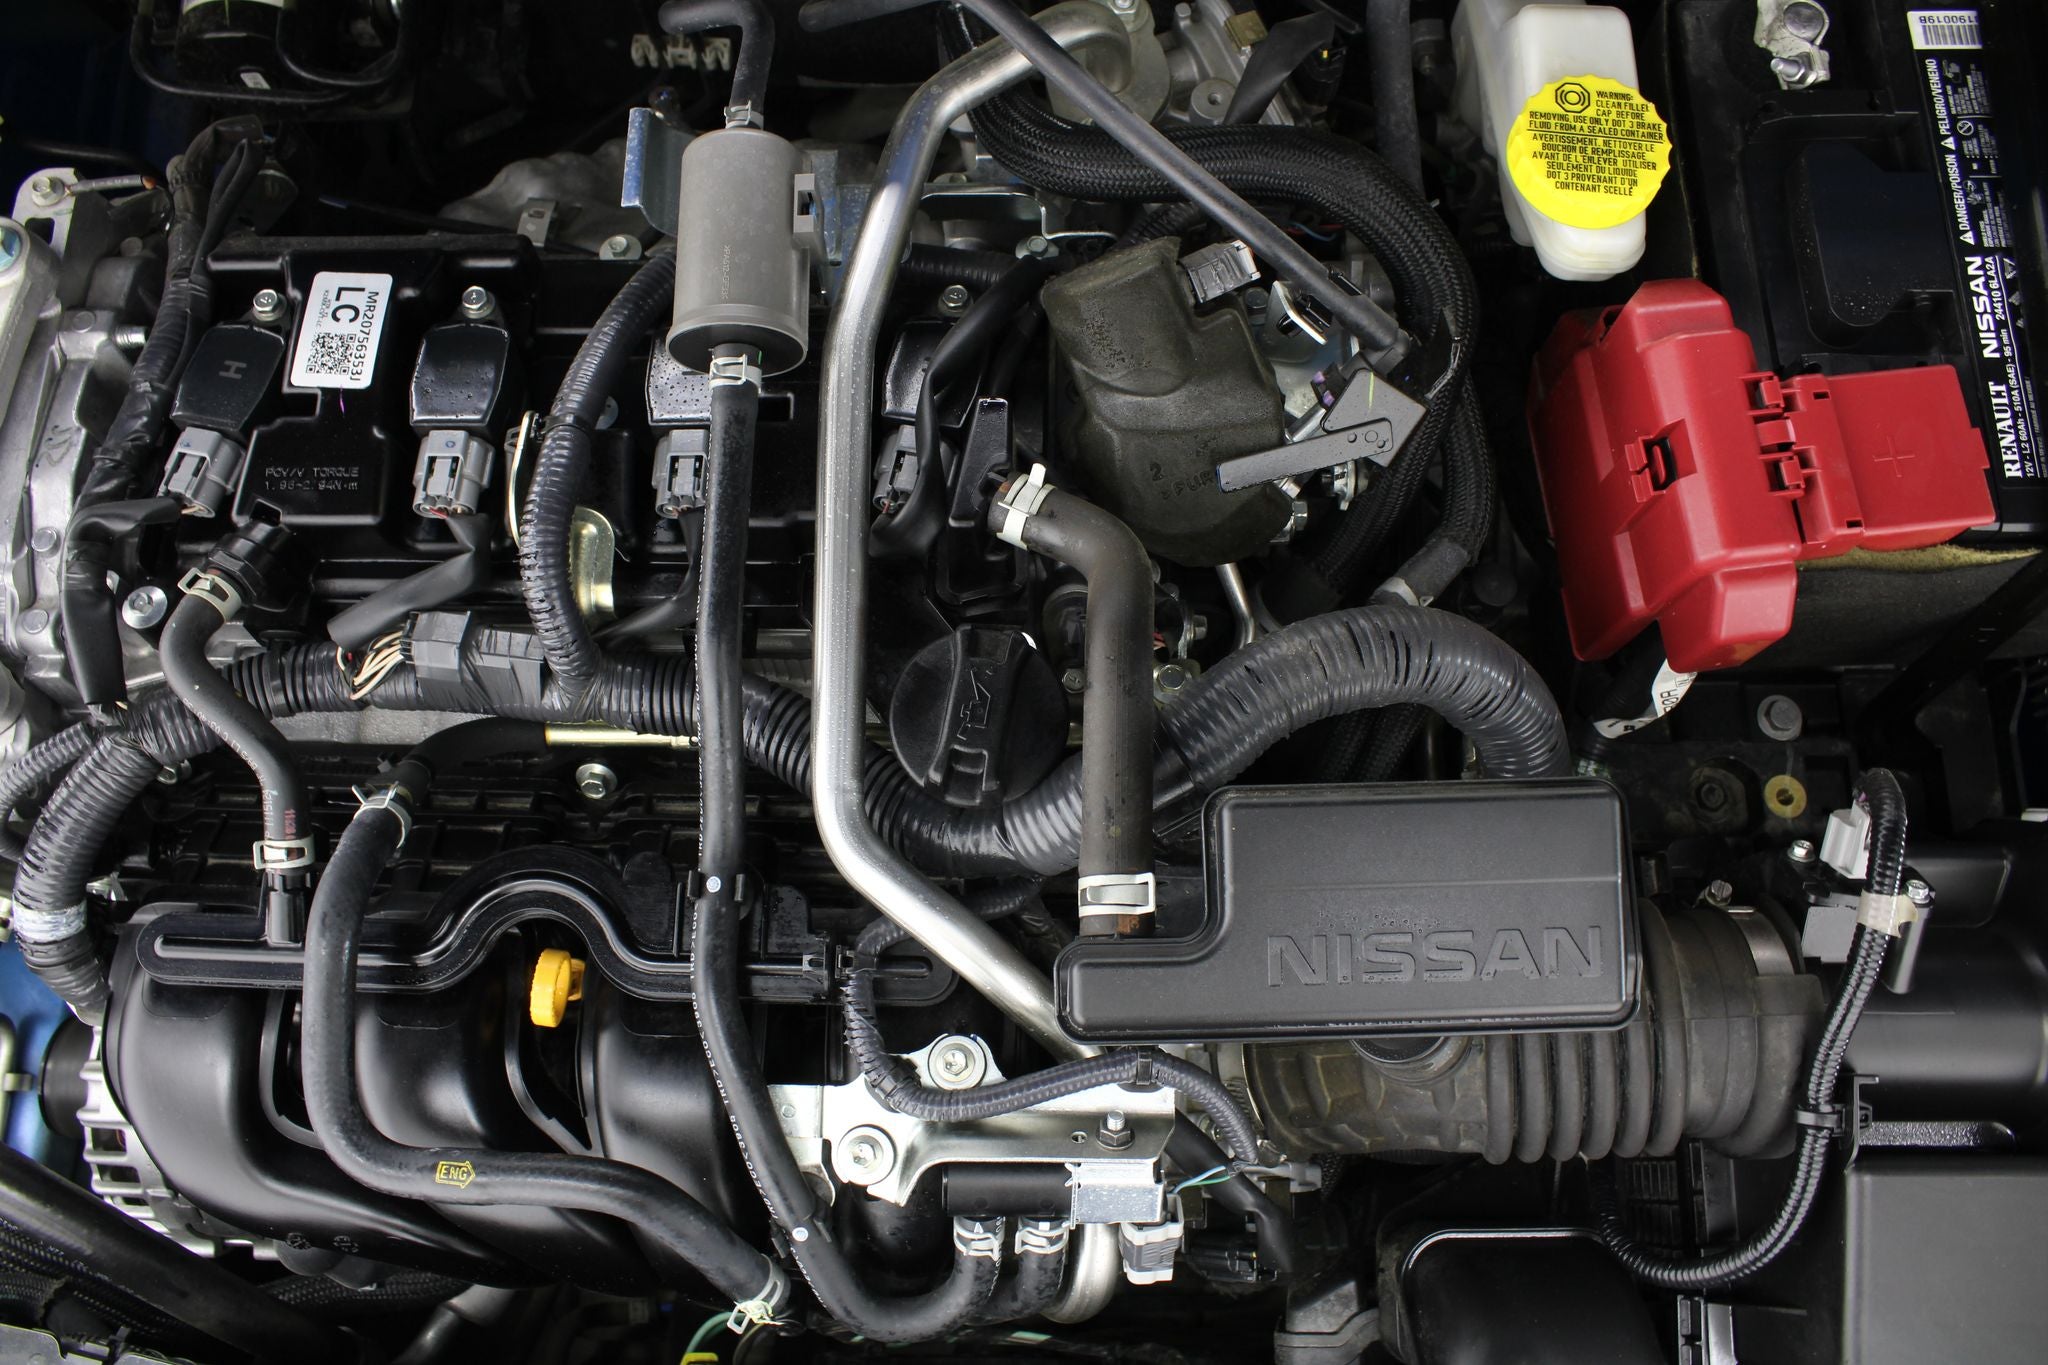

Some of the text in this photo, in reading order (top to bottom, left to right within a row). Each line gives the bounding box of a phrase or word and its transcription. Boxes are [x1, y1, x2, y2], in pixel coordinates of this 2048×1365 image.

[1596, 100, 1621, 109] CLEAN
[1573, 115, 1588, 124] USE
[1589, 116, 1609, 126] ONLY
[1612, 119, 1626, 127] DOT
[1629, 121, 1634, 129] 3
[1636, 122, 1662, 132] BRAKE
[1596, 109, 1645, 121] CAP BEFORE
[1529, 120, 1663, 141] FLUID FROM A SEALED CONTAINER
[1541, 142, 1646, 160] BOUCHON DE REMPLISSAGE
[1603, 139, 1643, 151] NETTOYER
[1645, 144, 1655, 152] LE
[1925, 58, 1970, 231] DANGER/POISON PELIGRO/VENENO
[1532, 151, 1560, 161] AVANT
[1563, 154, 1572, 162] DE
[1622, 160, 1657, 171] UTILISER
[1546, 161, 1638, 178] SEULEMENT DU LIQUIDE
[1546, 170, 1564, 179] DOT
[1564, 172, 1569, 180] 3
[1570, 172, 1618, 185] PROVENANT
[1555, 181, 1601, 193] CONTENANT
[1985, 257, 1999, 289] 6LA2A
[331, 286, 365, 323] LC
[1965, 256, 2000, 358] NISSAN
[1991, 291, 2004, 320] 24410
[2000, 329, 2009, 343] min
[2004, 346, 2012, 357] 95
[2006, 364, 2019, 388] (SAE)
[2011, 389, 2022, 411] 510A
[1988, 381, 2022, 478] RENAULT
[2018, 418, 2028, 441] 60Ah
[2022, 442, 2029, 454] L2
[313, 467, 359, 478] TORQUE
[2024, 461, 2035, 477] 12V
[1267, 925, 1601, 987] NISSAN
[440, 1165, 468, 1181] ENG
